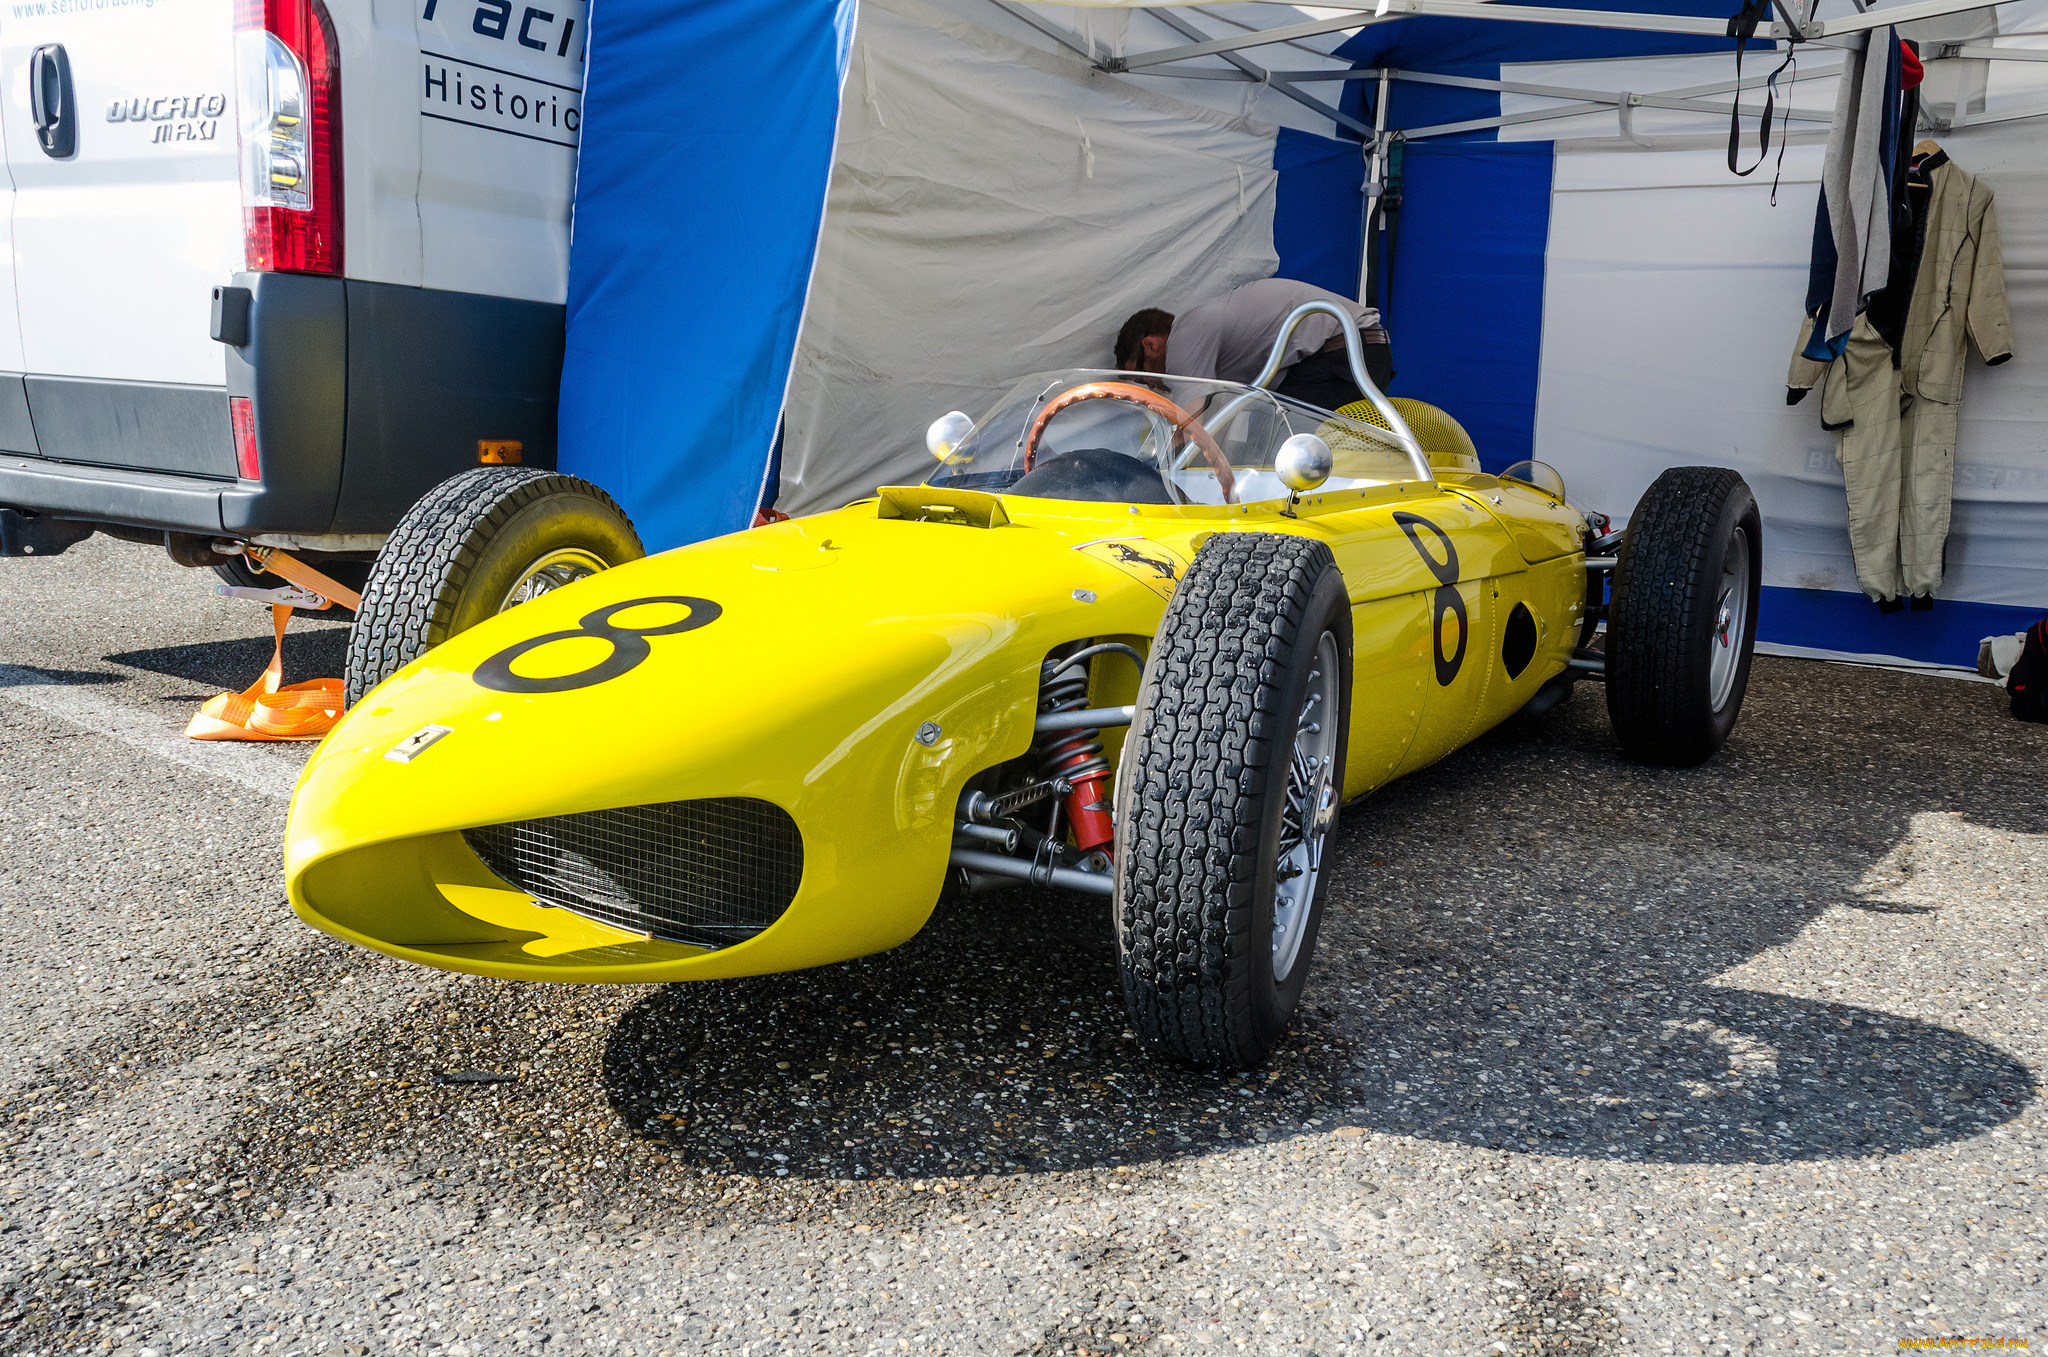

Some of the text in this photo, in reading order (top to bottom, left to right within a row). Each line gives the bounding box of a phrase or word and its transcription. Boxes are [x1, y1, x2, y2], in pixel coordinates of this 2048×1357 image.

[106, 93, 226, 123] DUCATO
[150, 120, 217, 144] MAXI
[425, 64, 580, 132] Historic
[1392, 511, 1468, 687] 8
[472, 595, 723, 693] 8
